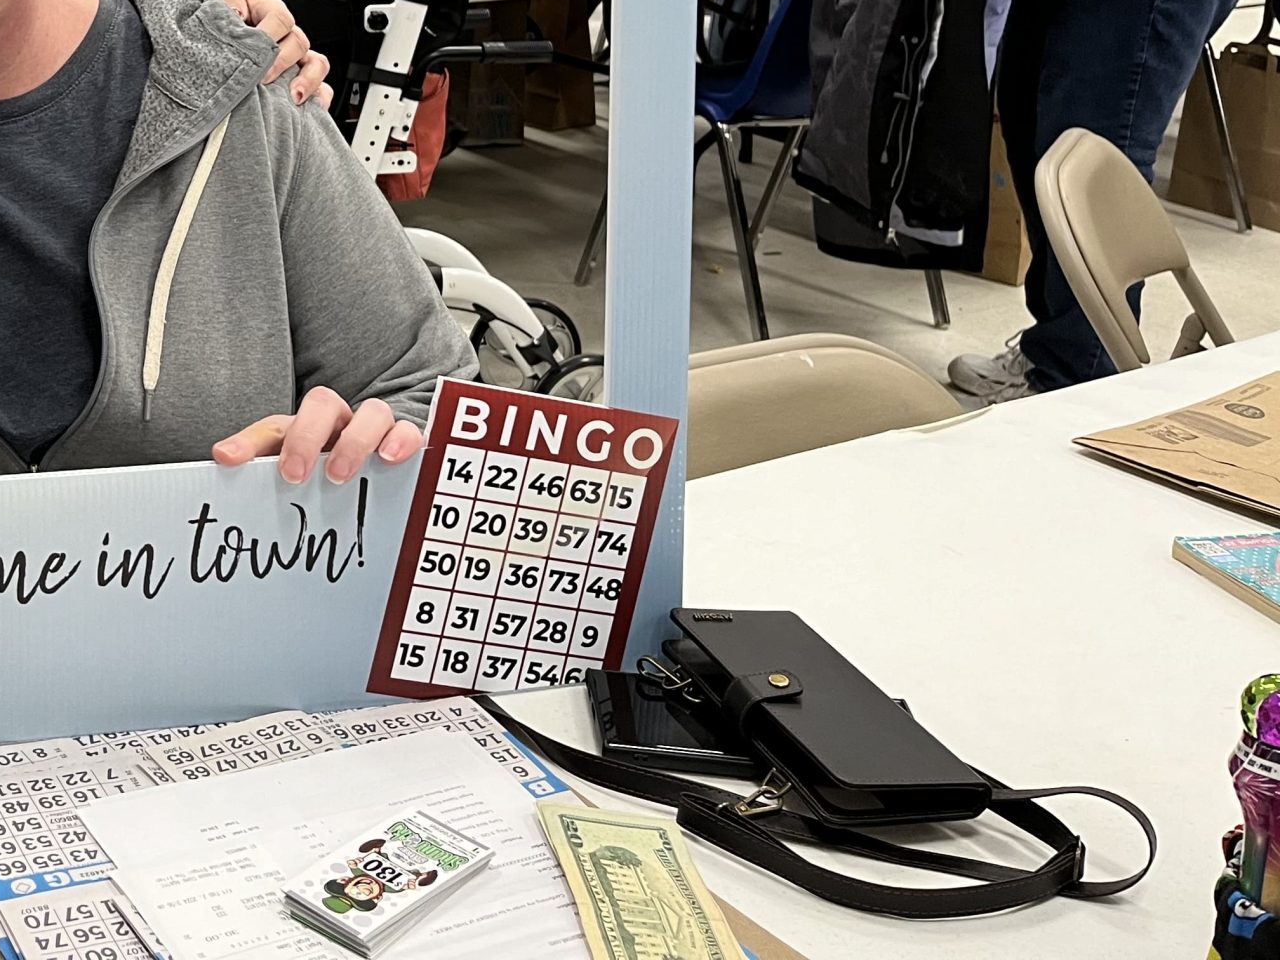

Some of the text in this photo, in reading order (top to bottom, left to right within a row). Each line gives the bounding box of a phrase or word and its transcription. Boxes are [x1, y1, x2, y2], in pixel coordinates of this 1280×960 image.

[450, 396, 663, 470] BINGO
[446, 458, 633, 509] 14 22 46 63 15
[97, 533, 176, 601] in
[186, 476, 370, 585] town!
[432, 504, 627, 556] 10 20 39 57 74
[419, 551, 622, 601] 50 19 36 73 48
[416, 601, 599, 648] 8 31 57 28 9
[399, 643, 425, 667] 15
[442, 649, 469, 674] 18
[482, 655, 517, 680] 37
[524, 662, 559, 686] 54
[351, 707, 462, 736] 4 20 33 48
[201, 718, 312, 758] 13 25 32 57
[32, 748, 48, 758] 8
[182, 732, 323, 780] 6 27 41 47 68
[62, 771, 92, 785] 22
[106, 768, 119, 780] 7
[27, 776, 57, 792] 32
[2, 800, 30, 814] 48
[39, 794, 67, 808] 39
[12, 817, 43, 831] 54
[23, 835, 53, 850] 53
[58, 830, 87, 844] 42
[33, 853, 64, 869] 55
[70, 847, 99, 862] 43
[24, 912, 57, 929] 70
[65, 904, 95, 922] 57
[35, 925, 106, 950] 56 74
